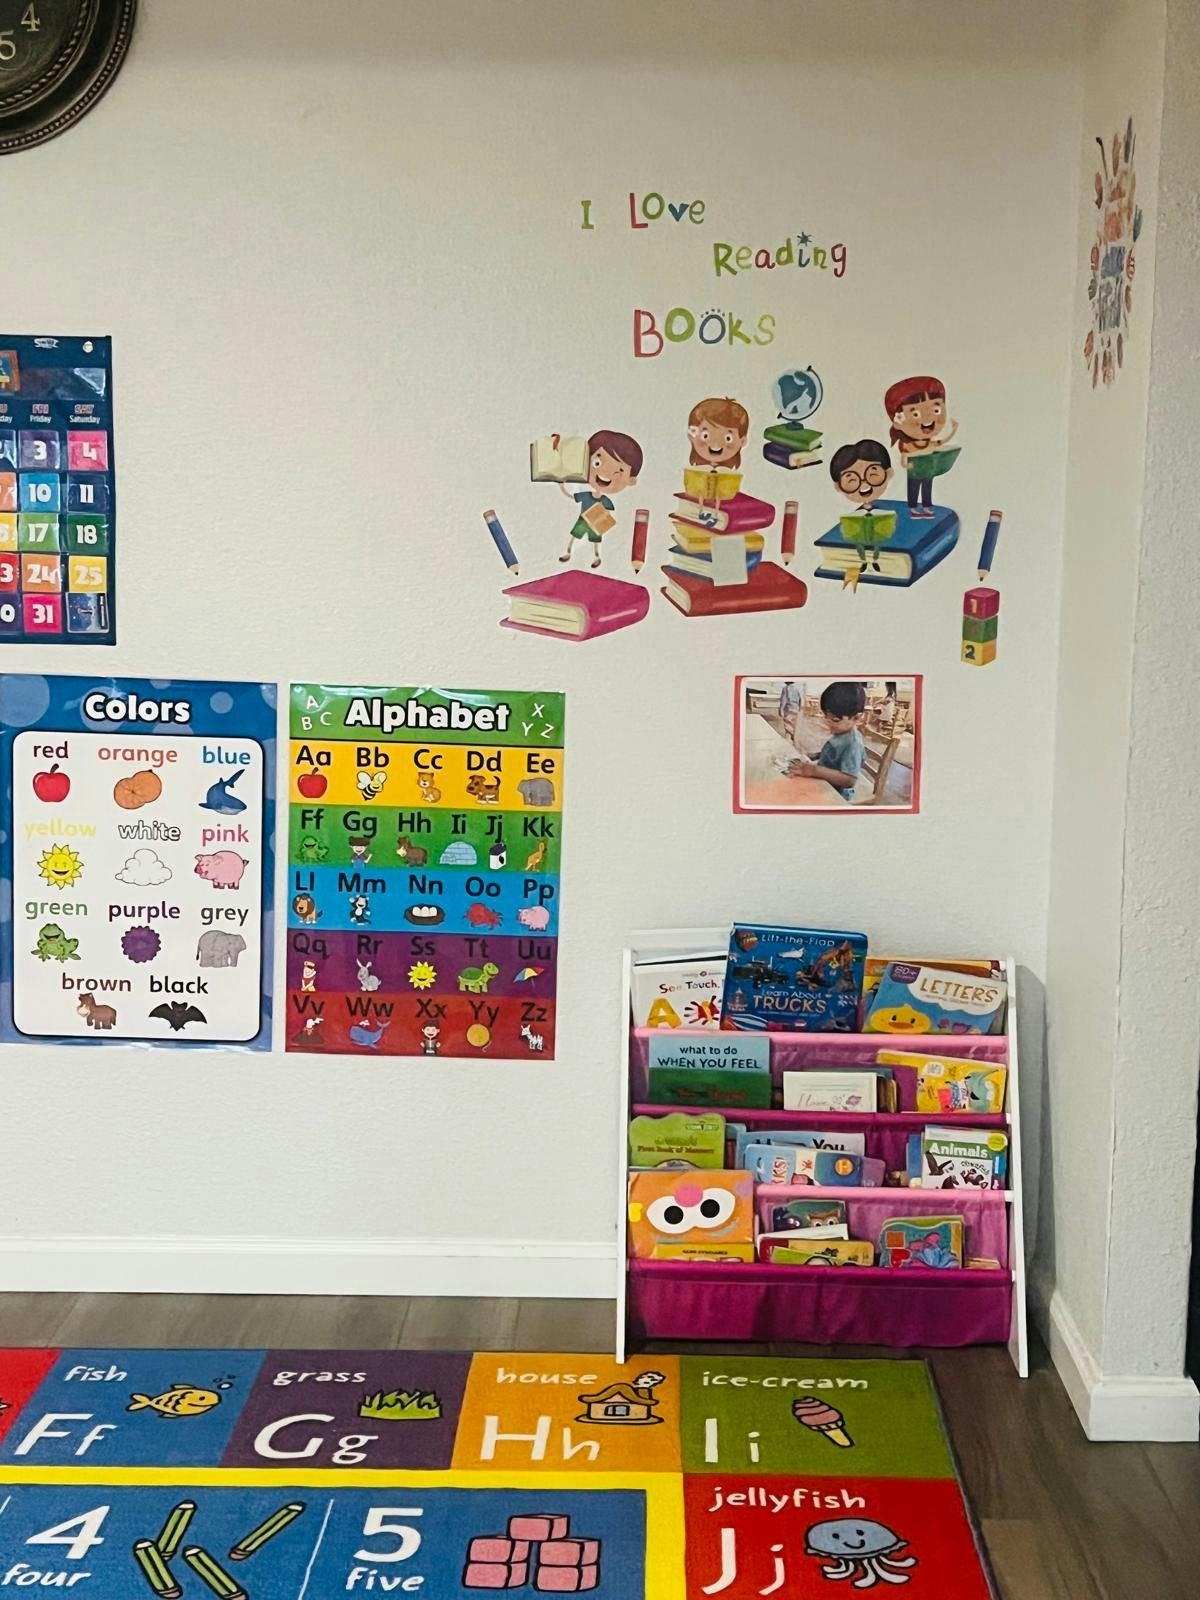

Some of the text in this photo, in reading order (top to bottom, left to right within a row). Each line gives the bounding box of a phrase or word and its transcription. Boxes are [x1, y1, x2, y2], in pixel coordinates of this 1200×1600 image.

[21, 2, 40, 32] 4
[581, 200, 594, 229] I
[713, 231, 848, 278] Reading
[29, 414, 52, 424] Friday
[69, 414, 101, 425] Saturday
[33, 440, 97, 461] 3 4
[28, 483, 94, 503] 10 11
[28, 523, 49, 542] 17
[76, 524, 98, 545] 18
[27, 564, 56, 584] 24
[75, 564, 102, 585] 25
[32, 604, 54, 624] 31
[965, 645, 975, 660] 2
[85, 694, 190, 723] Colors
[345, 698, 510, 732] Alphabet
[532, 703, 545, 718] X
[33, 741, 251, 768] red orange blue
[296, 745, 555, 773] Aa Bb Cc Dd Ee
[24, 820, 250, 847] yellow white pink
[301, 809, 554, 842] Ff Gg Hh Ii Jj Kk
[338, 872, 386, 894] Mm
[409, 874, 443, 895] Nn
[465, 876, 501, 897] Oo
[523, 878, 554, 905] Pp
[25, 900, 249, 926] green purple grey
[293, 933, 551, 960] Qq Rr Ss Tt Uu
[62, 973, 209, 994] brown black
[920, 978, 998, 1003] LETTERS
[292, 995, 547, 1027] Vv Ww Xx Yy Zz
[753, 995, 826, 1013] TRUCKS
[658, 1057, 761, 1069] WHEN YOU FEEL
[680, 1046, 738, 1055] what to do
[929, 1142, 988, 1158] Animals
[64, 1365, 868, 1390] fish grass house ice-cream
[708, 1487, 866, 1513] jellyfish
[25, 1506, 424, 1562] 4 5
[1, 1564, 425, 1591] four five
